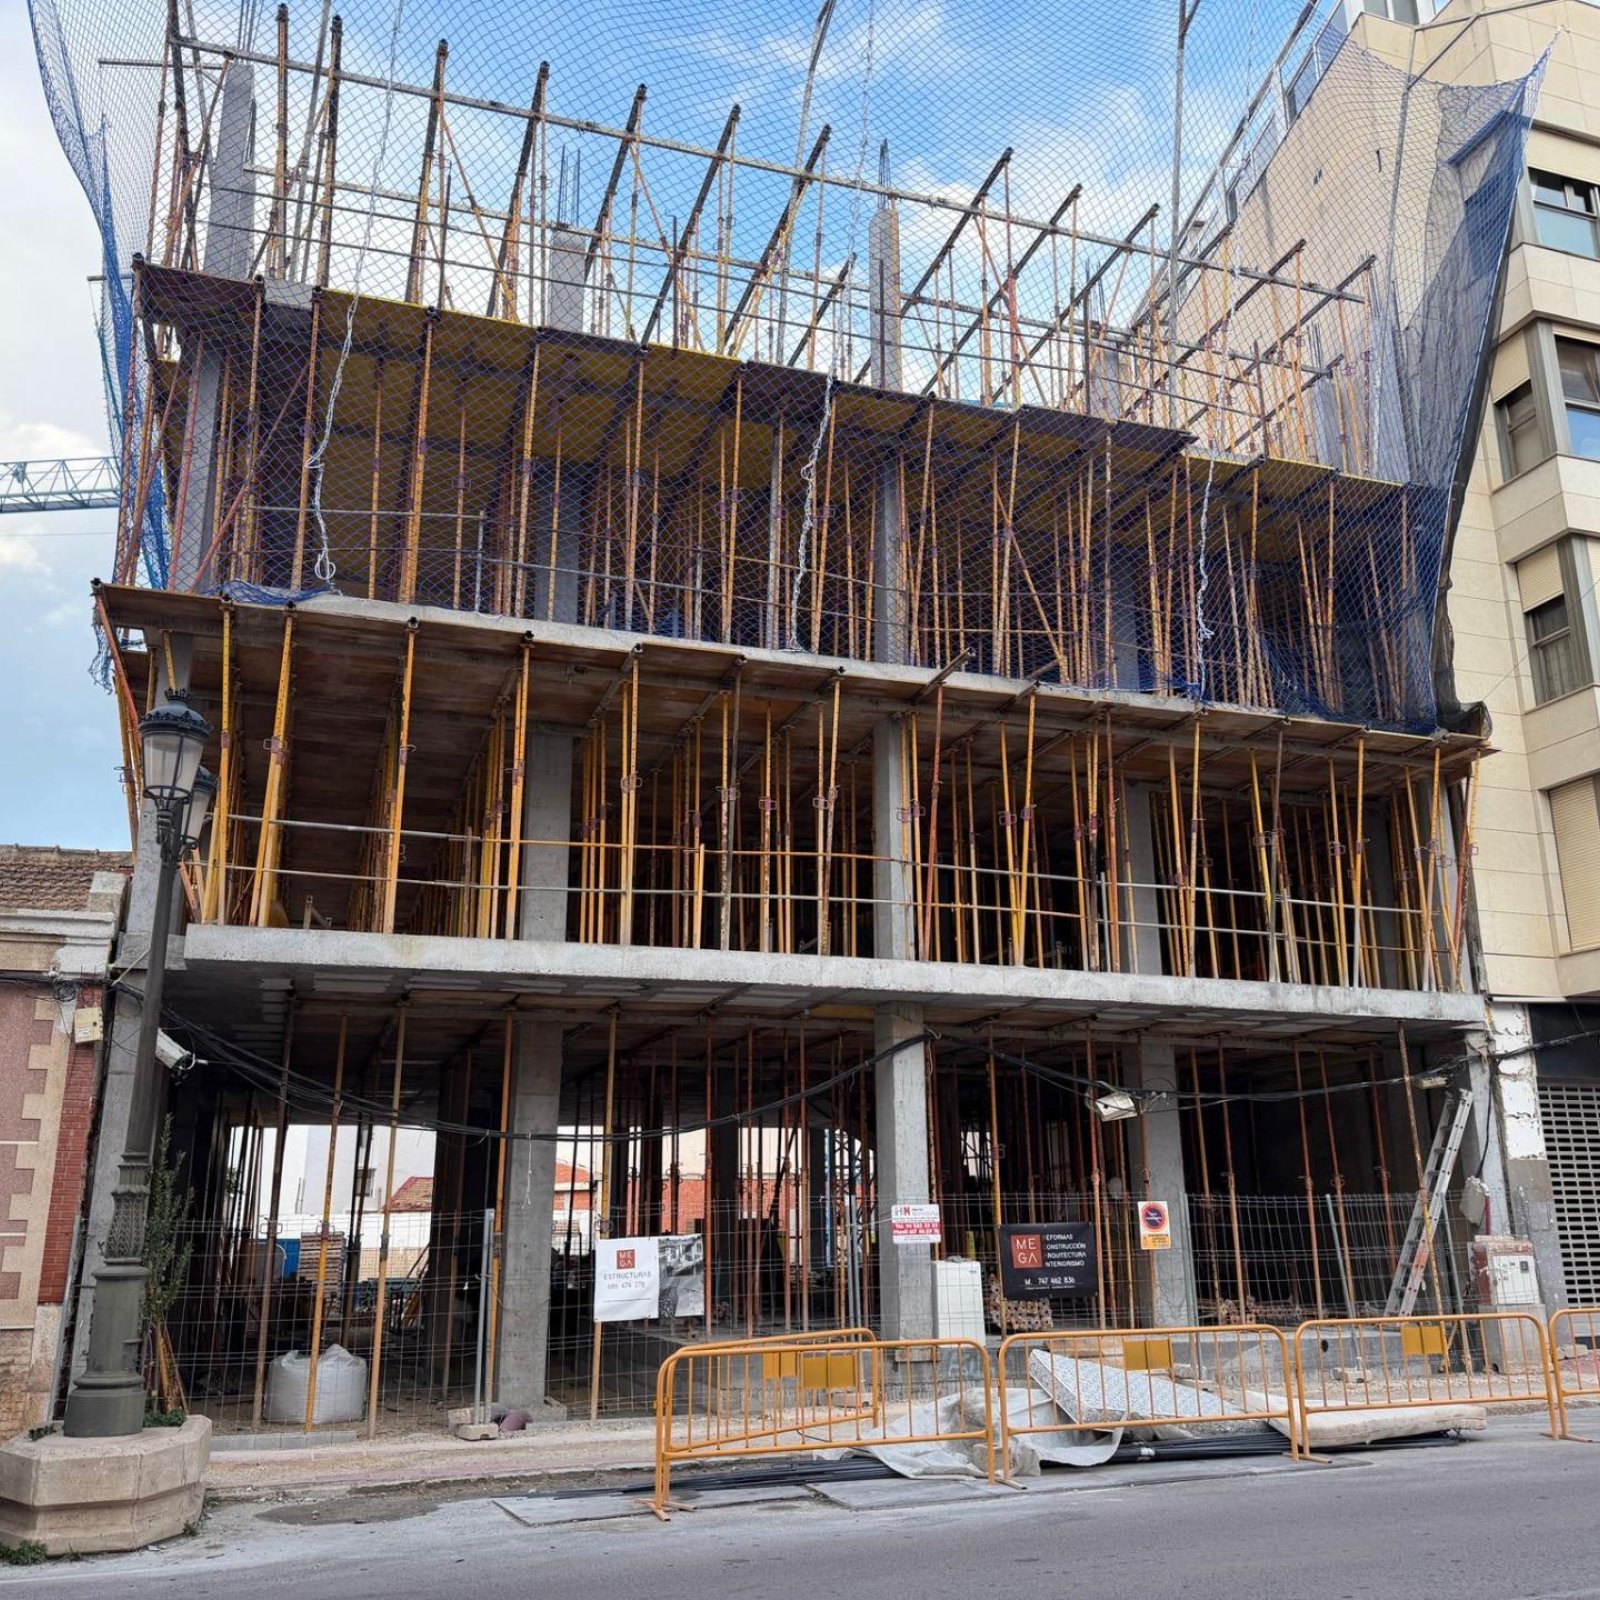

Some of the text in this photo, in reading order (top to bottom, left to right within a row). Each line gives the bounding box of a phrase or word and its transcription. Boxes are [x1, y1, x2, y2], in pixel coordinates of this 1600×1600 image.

[1042, 1233, 1073, 1241] EFORMAS
[1016, 1237, 1037, 1250] ME
[1042, 1242, 1087, 1250] ONSTRUCCIÓN
[1018, 1252, 1038, 1264] GA
[603, 1271, 651, 1280] ESTRUCTURAS
